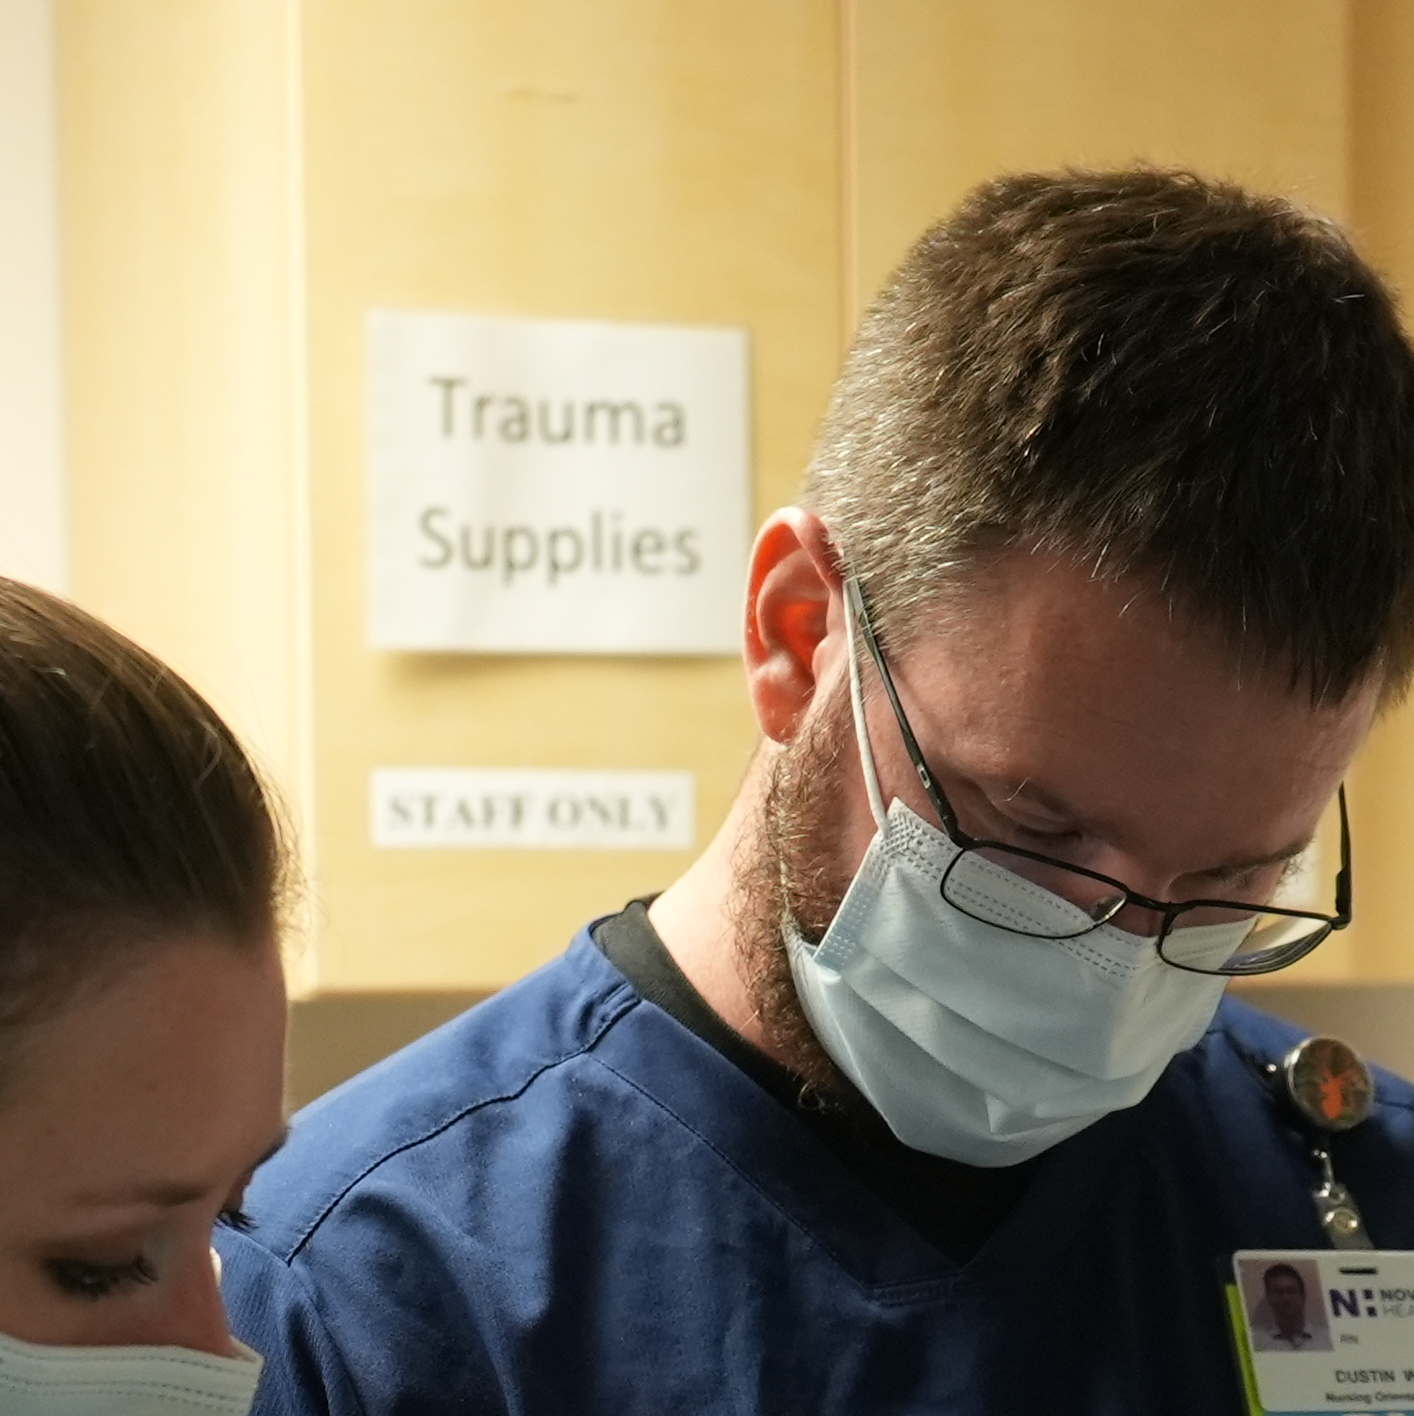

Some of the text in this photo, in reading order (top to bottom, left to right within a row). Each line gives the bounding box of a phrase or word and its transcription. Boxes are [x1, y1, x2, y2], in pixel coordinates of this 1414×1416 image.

[428, 373, 688, 447] Trauma
[417, 506, 703, 587] Supplies
[387, 795, 678, 832] STAFF ONLY
